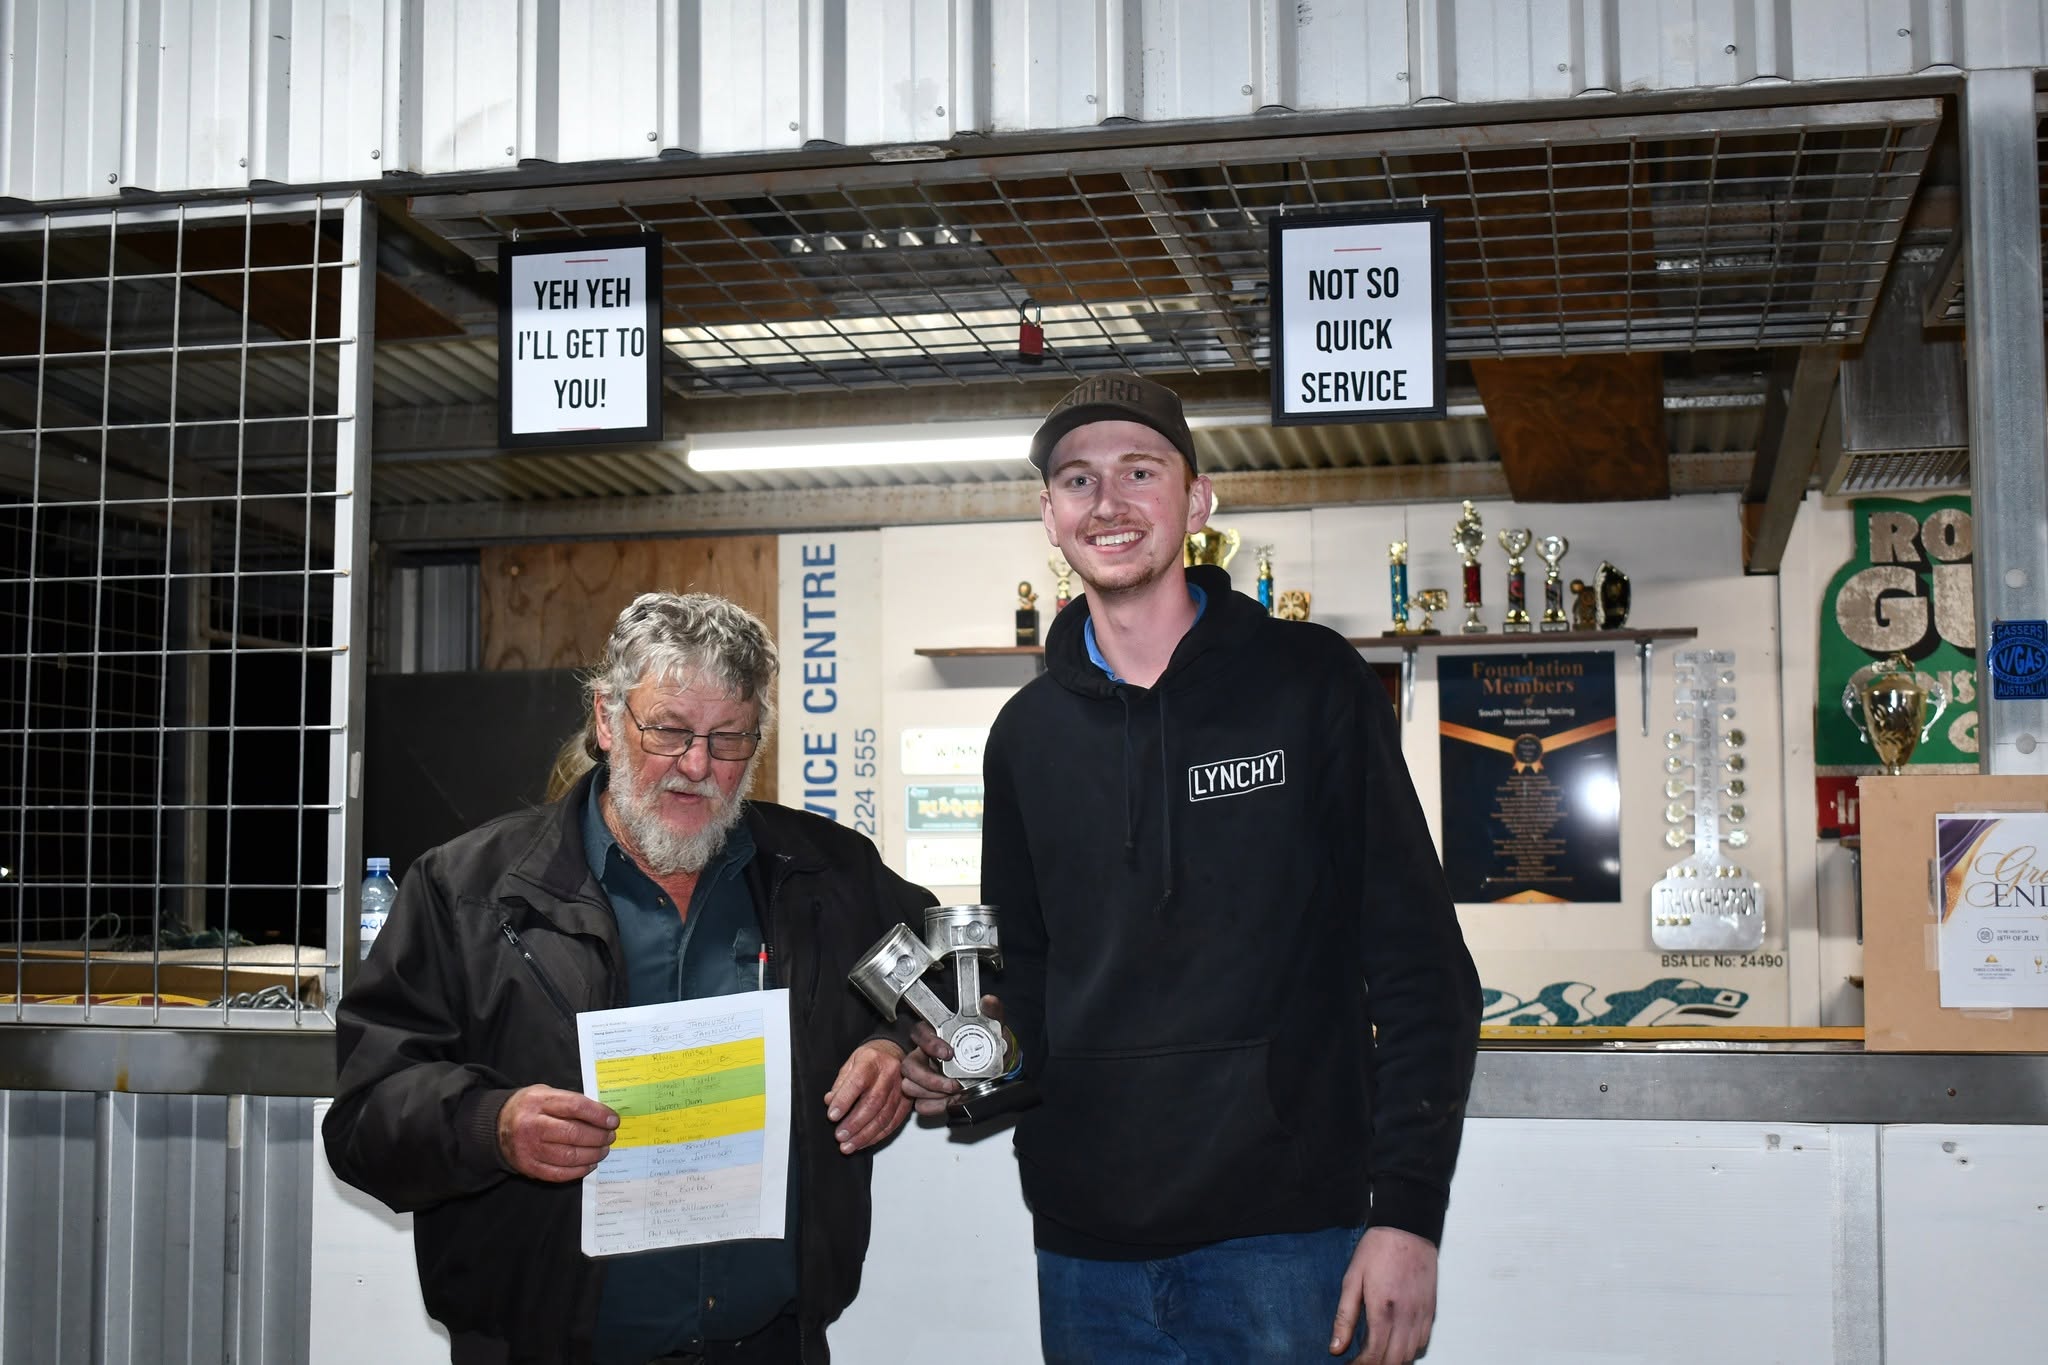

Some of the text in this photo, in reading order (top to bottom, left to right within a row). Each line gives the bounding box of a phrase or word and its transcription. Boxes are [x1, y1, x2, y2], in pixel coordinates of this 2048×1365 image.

[533, 277, 631, 311] YEH YEH
[1309, 267, 1399, 301] NOT SO
[518, 327, 644, 360] I'LL GET TO
[1316, 318, 1393, 353] QUICK
[554, 378, 606, 409] YOU!
[1301, 370, 1407, 404] SERVICE
[802, 543, 837, 714] CENTRE
[1996, 624, 2043, 640] GASSERS
[1472, 659, 1584, 679] Foundation
[1483, 677, 1576, 695] Members
[1998, 682, 2046, 696] AUSTRALIA
[1478, 707, 1575, 717] South West Drag Racing
[1503, 718, 1550, 726] Association
[854, 728, 877, 777] 555
[1194, 754, 1279, 795] LYNCHY
[1697, 887, 1757, 915] CHAMPION
[1661, 954, 1784, 967] BSA Lic No: 24490
